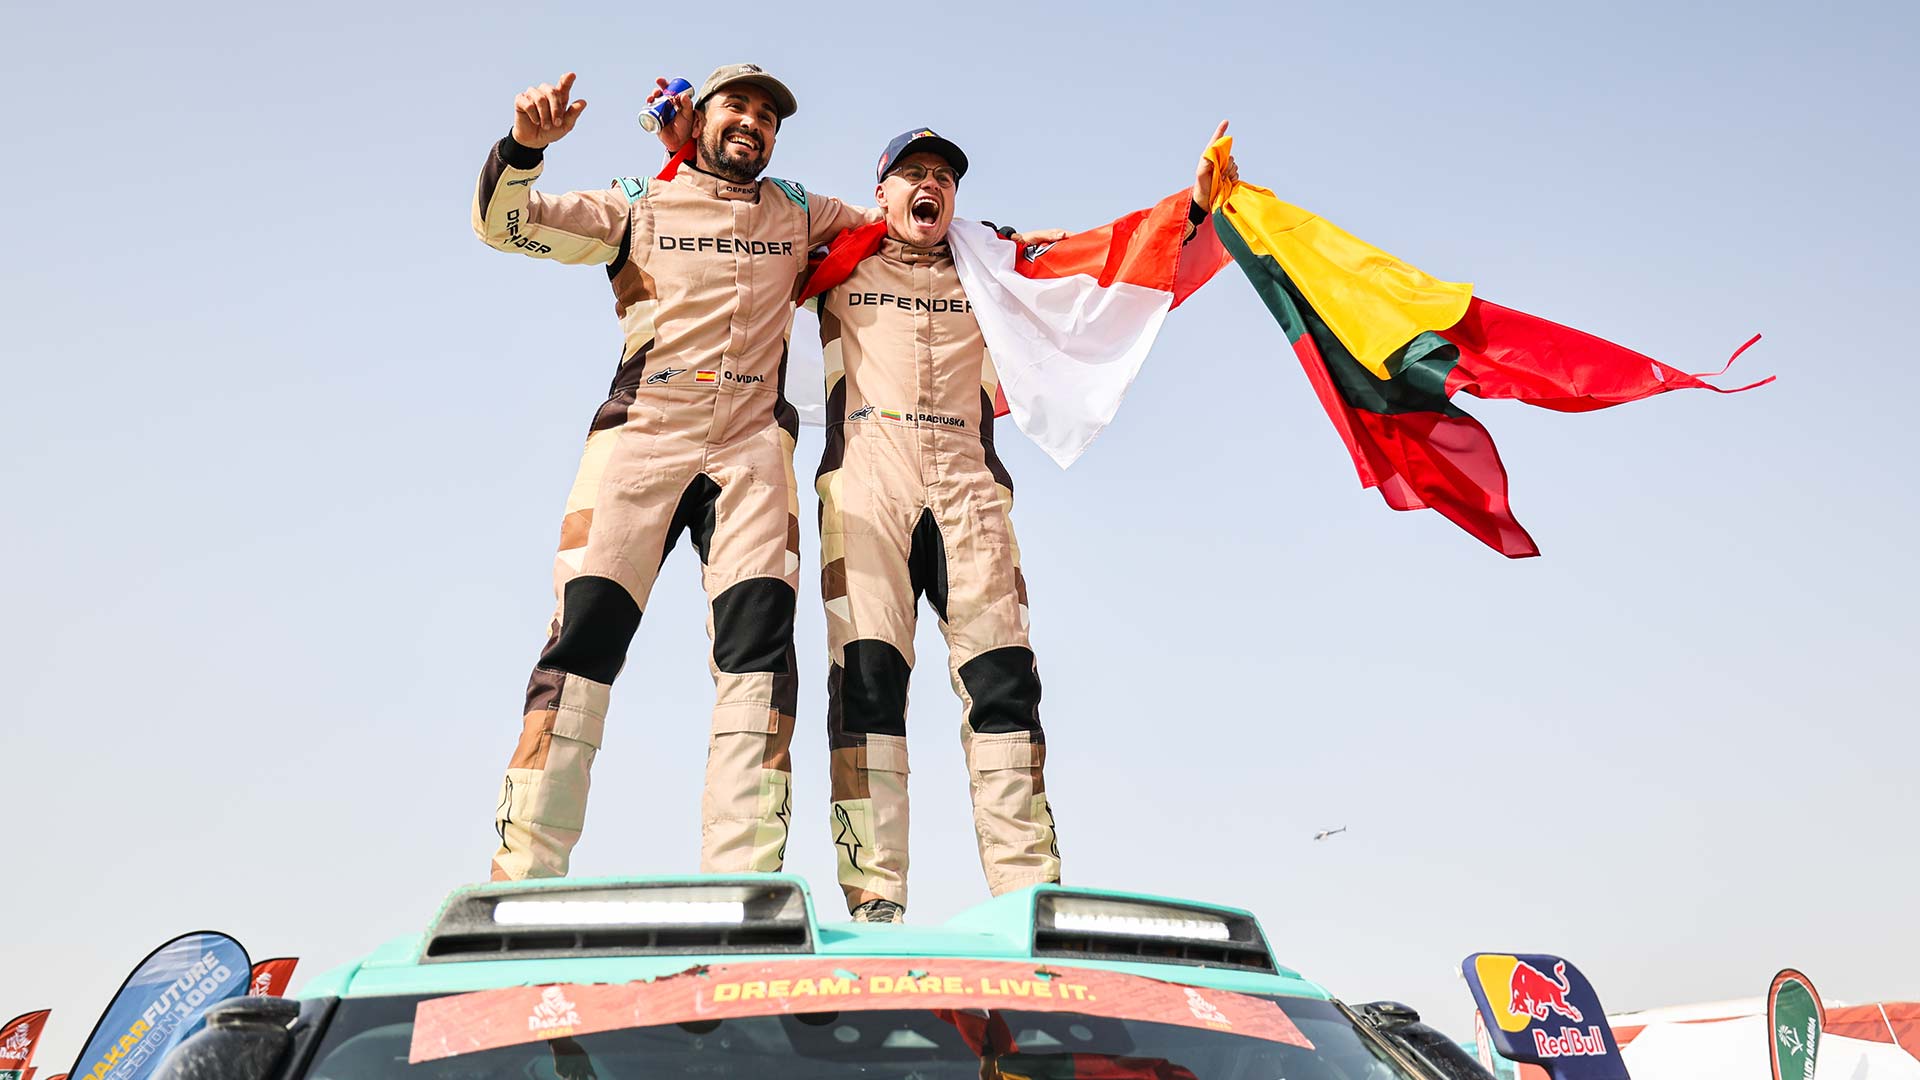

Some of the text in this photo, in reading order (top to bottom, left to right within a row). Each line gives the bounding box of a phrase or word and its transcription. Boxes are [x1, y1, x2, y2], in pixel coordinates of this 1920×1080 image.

[659, 236, 793, 256] DEFENDER
[713, 975, 1097, 1002] DREAM. DARE. LIVE IT.
